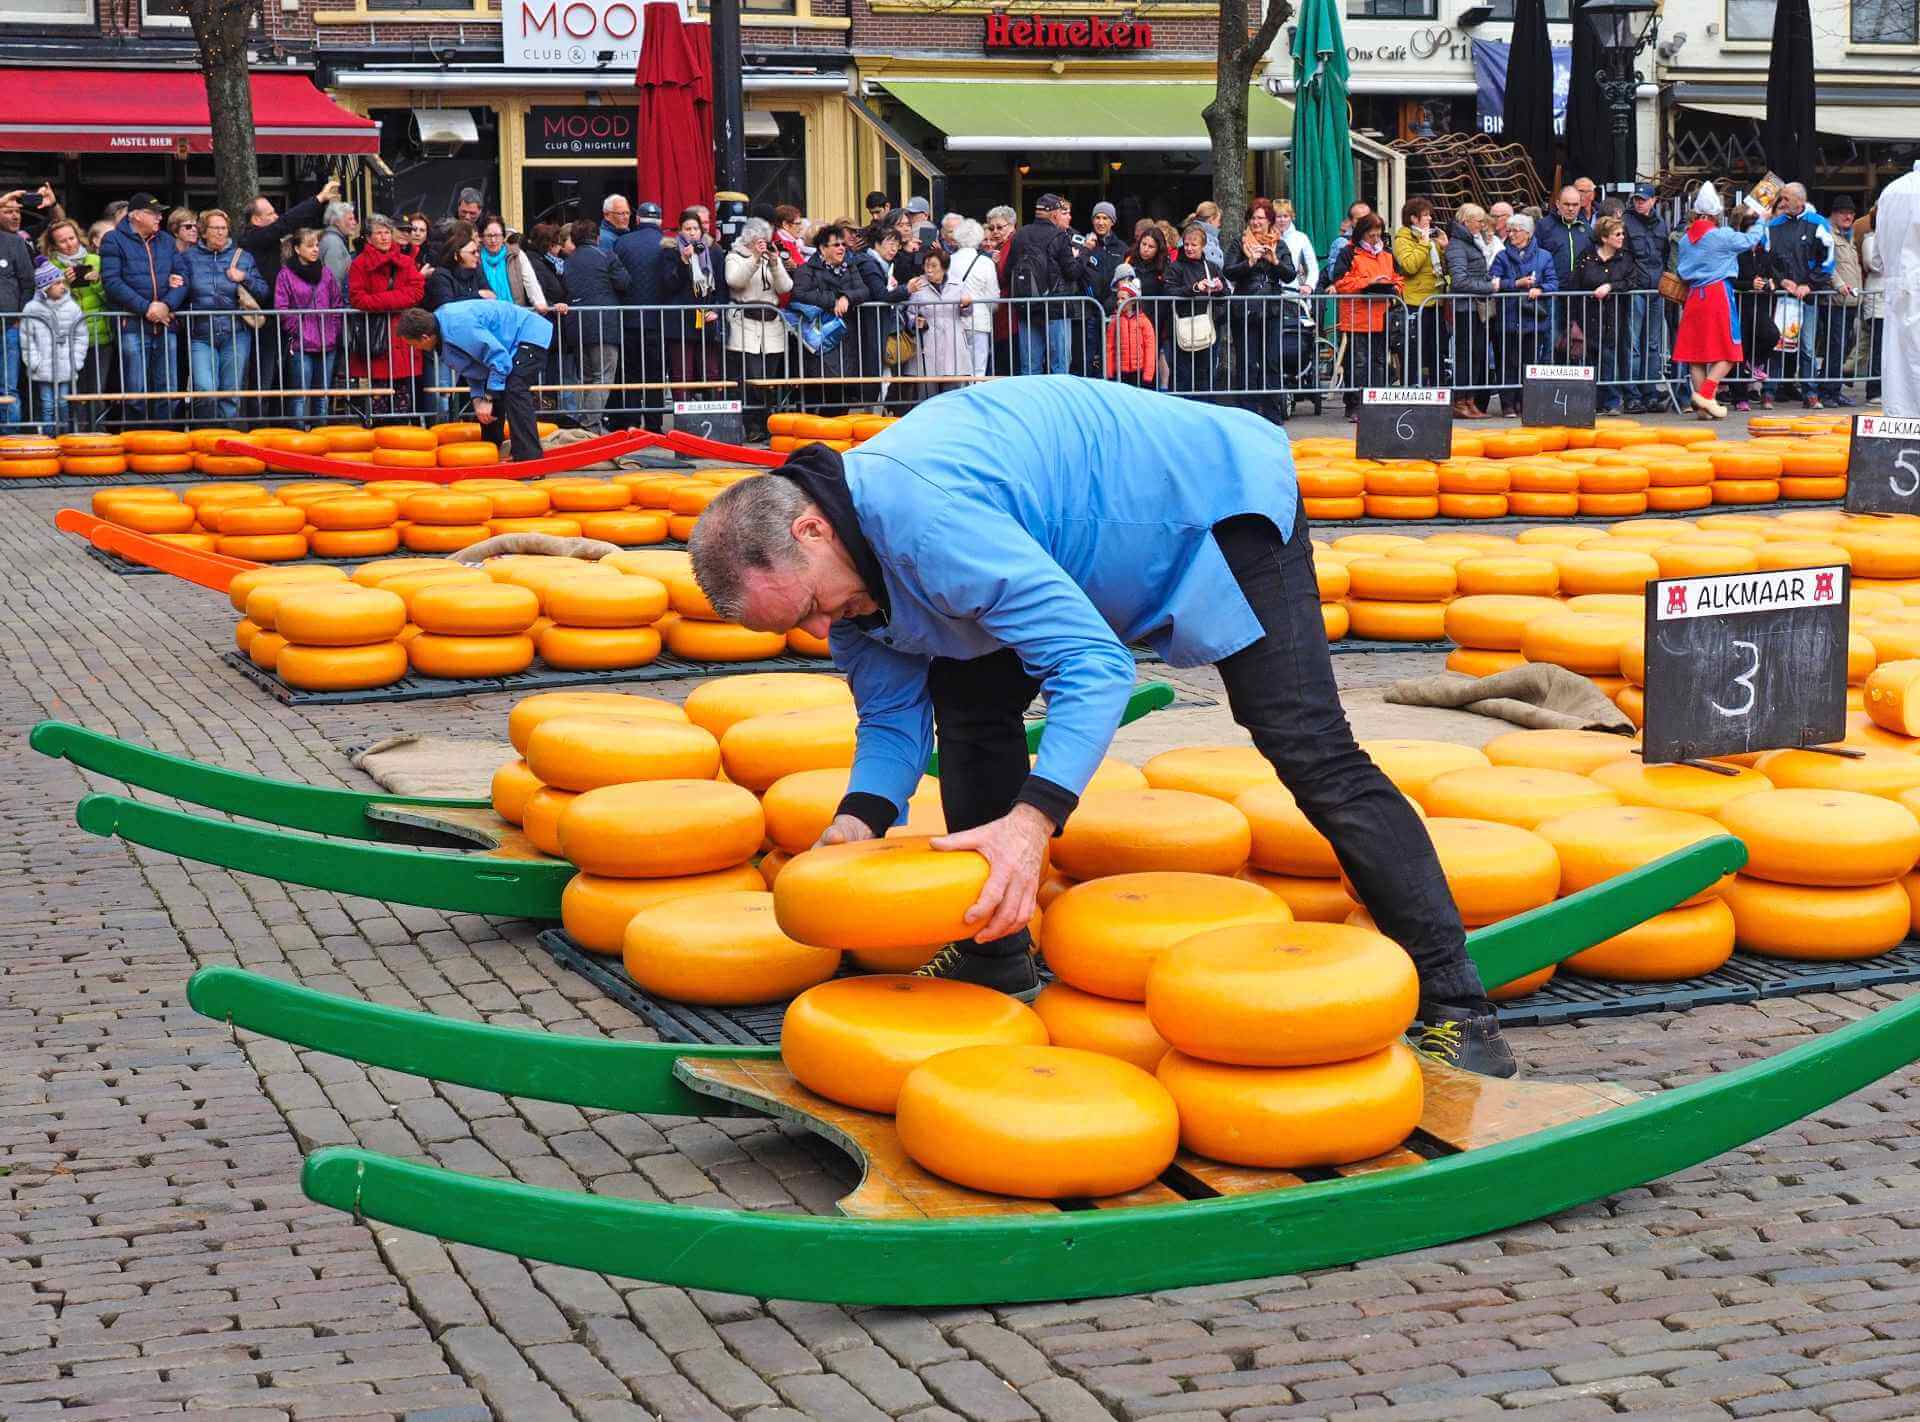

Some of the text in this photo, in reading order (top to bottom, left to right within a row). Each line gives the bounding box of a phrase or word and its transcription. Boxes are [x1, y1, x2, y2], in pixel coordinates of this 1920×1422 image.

[521, 2, 637, 40] MOO
[985, 14, 1153, 49] Heineken
[523, 49, 562, 60] CLUB
[1346, 25, 1473, 61] Ons Café Pri
[543, 115, 630, 137] MOOD
[110, 136, 173, 147] AMSTEL BIER
[545, 141, 568, 151] CLUB
[584, 141, 631, 151] NIGHTLIFE
[1539, 366, 1580, 378] ALKMAAR
[1380, 391, 1432, 402] ALKMAAR
[1553, 387, 1568, 416] 4
[1396, 408, 1415, 440] 6
[1878, 420, 1920, 434] ALKMA
[1889, 448, 1920, 496] 5
[1696, 578, 1805, 610] ALKMAAR
[1711, 640, 1760, 717] 3
